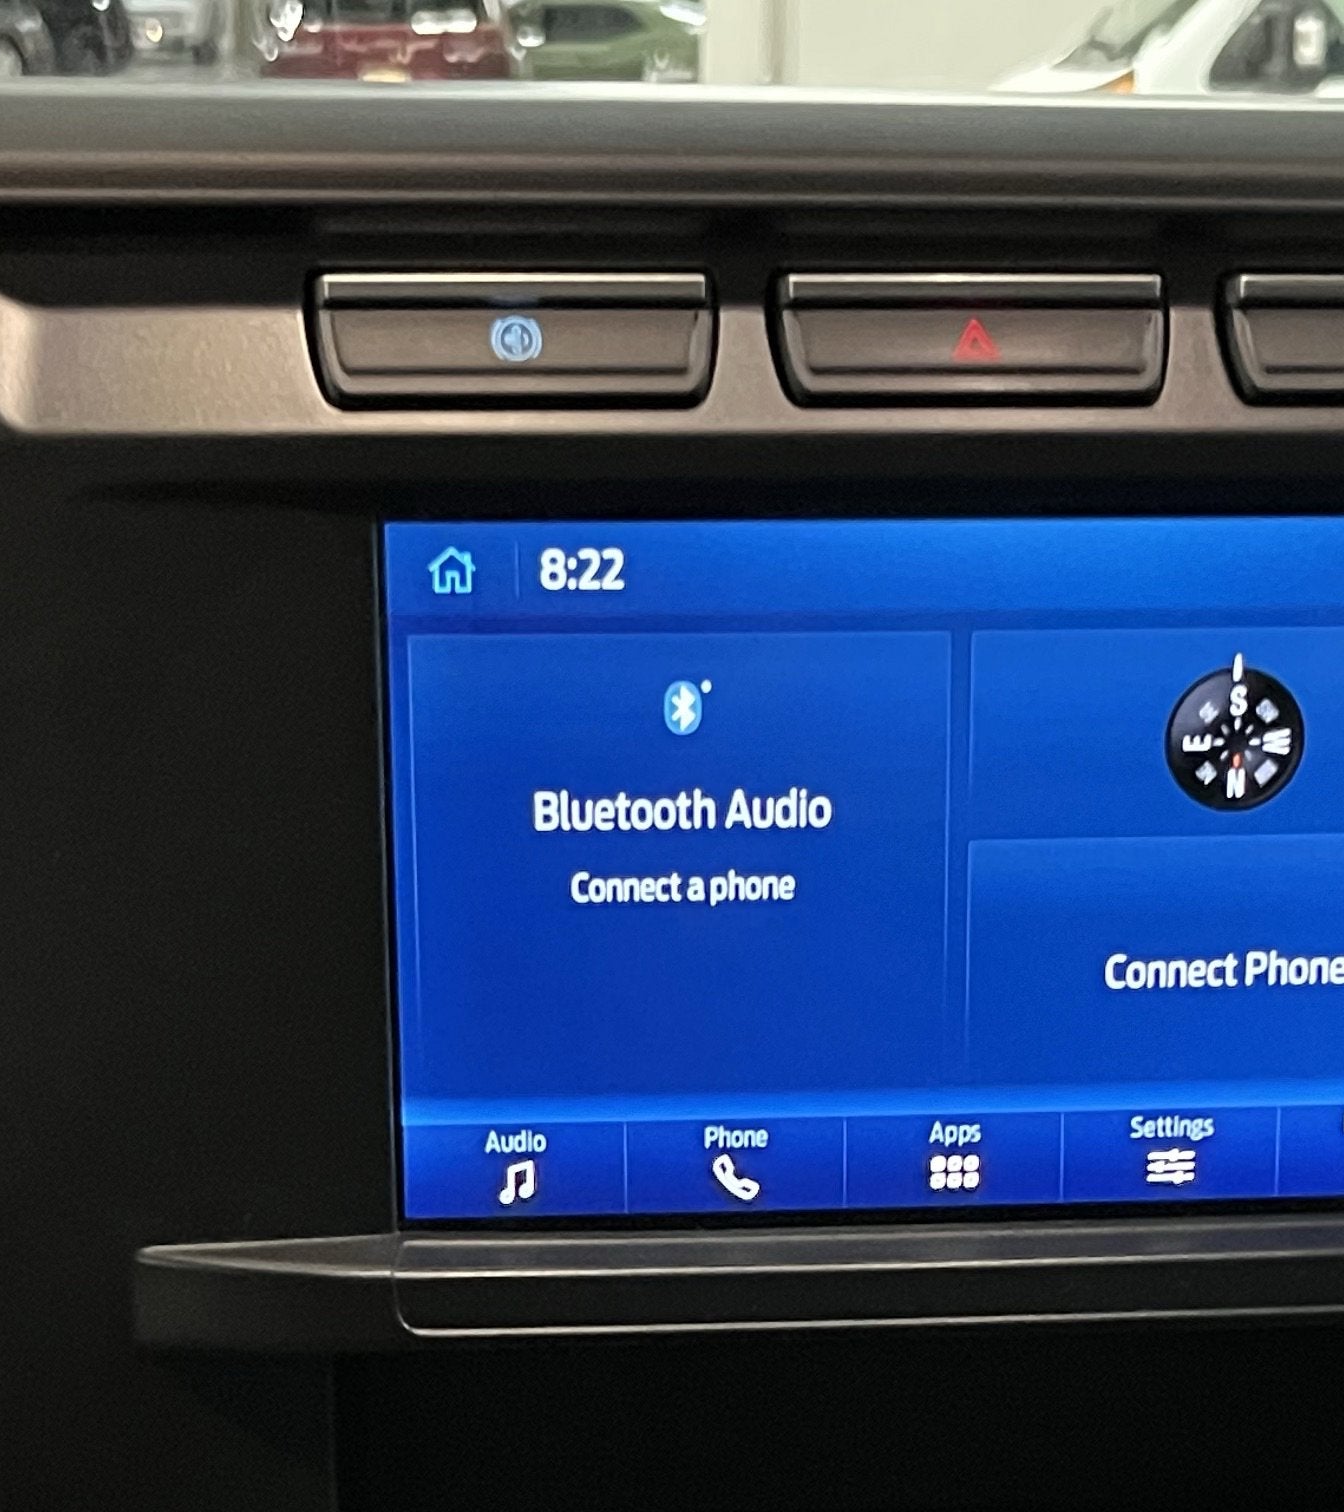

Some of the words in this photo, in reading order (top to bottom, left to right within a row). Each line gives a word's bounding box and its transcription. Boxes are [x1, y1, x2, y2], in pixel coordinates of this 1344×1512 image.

[539, 547, 625, 591] 8:22
[1229, 684, 1249, 717] S
[1182, 733, 1212, 753] E
[1262, 728, 1292, 756] W
[1226, 767, 1246, 799] N
[533, 787, 716, 832] Bluetooth
[724, 786, 833, 830] Audio
[570, 871, 682, 905] Connect
[687, 877, 706, 901] a
[709, 868, 796, 906] phone
[1104, 952, 1238, 990] Connect
[485, 1129, 547, 1154] Audio
[704, 1125, 769, 1149] Phone
[929, 1120, 982, 1147] Apps
[1129, 1115, 1215, 1141] Settings
